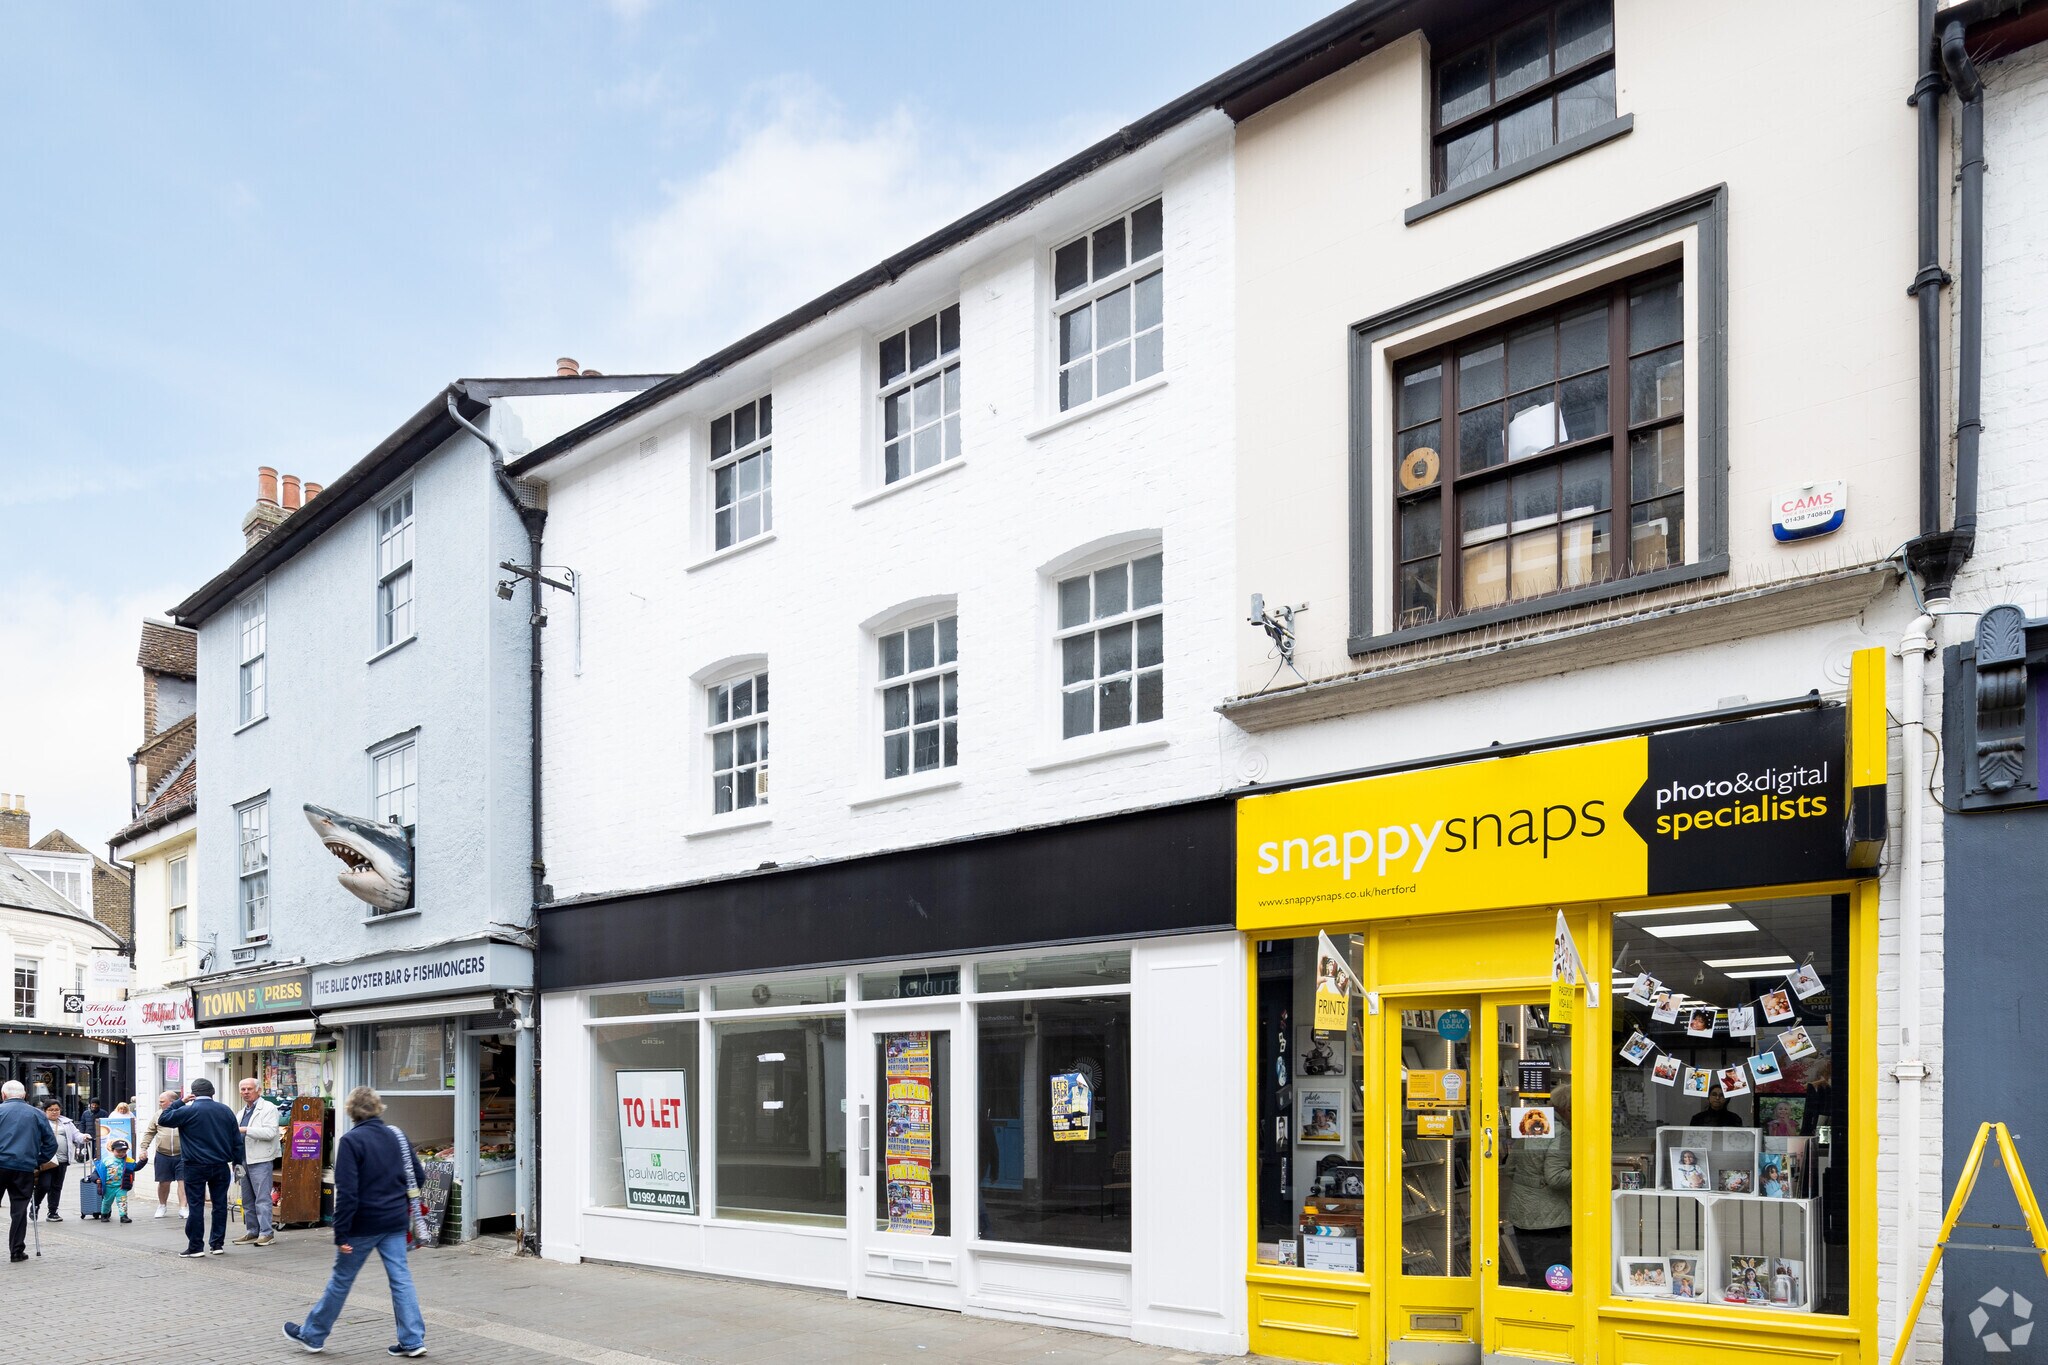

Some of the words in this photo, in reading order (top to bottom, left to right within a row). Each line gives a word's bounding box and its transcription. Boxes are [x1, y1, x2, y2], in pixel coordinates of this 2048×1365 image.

[1781, 492, 1833, 513] CAMS
[1785, 514, 1805, 524] 01438
[1807, 509, 1832, 519] 740840
[1656, 794, 1828, 840] specialists
[1258, 884, 1417, 908] www.snappysnaps.co.uk/hertford
[316, 980, 330, 995] THE
[331, 977, 350, 993] BLUE
[351, 971, 383, 991] OYSTER
[385, 969, 402, 986] BAR
[404, 968, 412, 983] &
[413, 956, 485, 982] FISHMONGERS
[203, 990, 246, 1017] TOWN
[248, 982, 302, 1010] EXPRESS
[1317, 999, 1346, 1016] PRINTS
[85, 1003, 126, 1014] Hertford
[86, 1014, 126, 1027] Nails
[1052, 1081, 1068, 1090] LET'S
[623, 1097, 645, 1128] TO
[650, 1098, 681, 1129] LET
[628, 1166, 686, 1182] paulwallace
[633, 1191, 656, 1203] 01992
[657, 1193, 686, 1206] 440744
